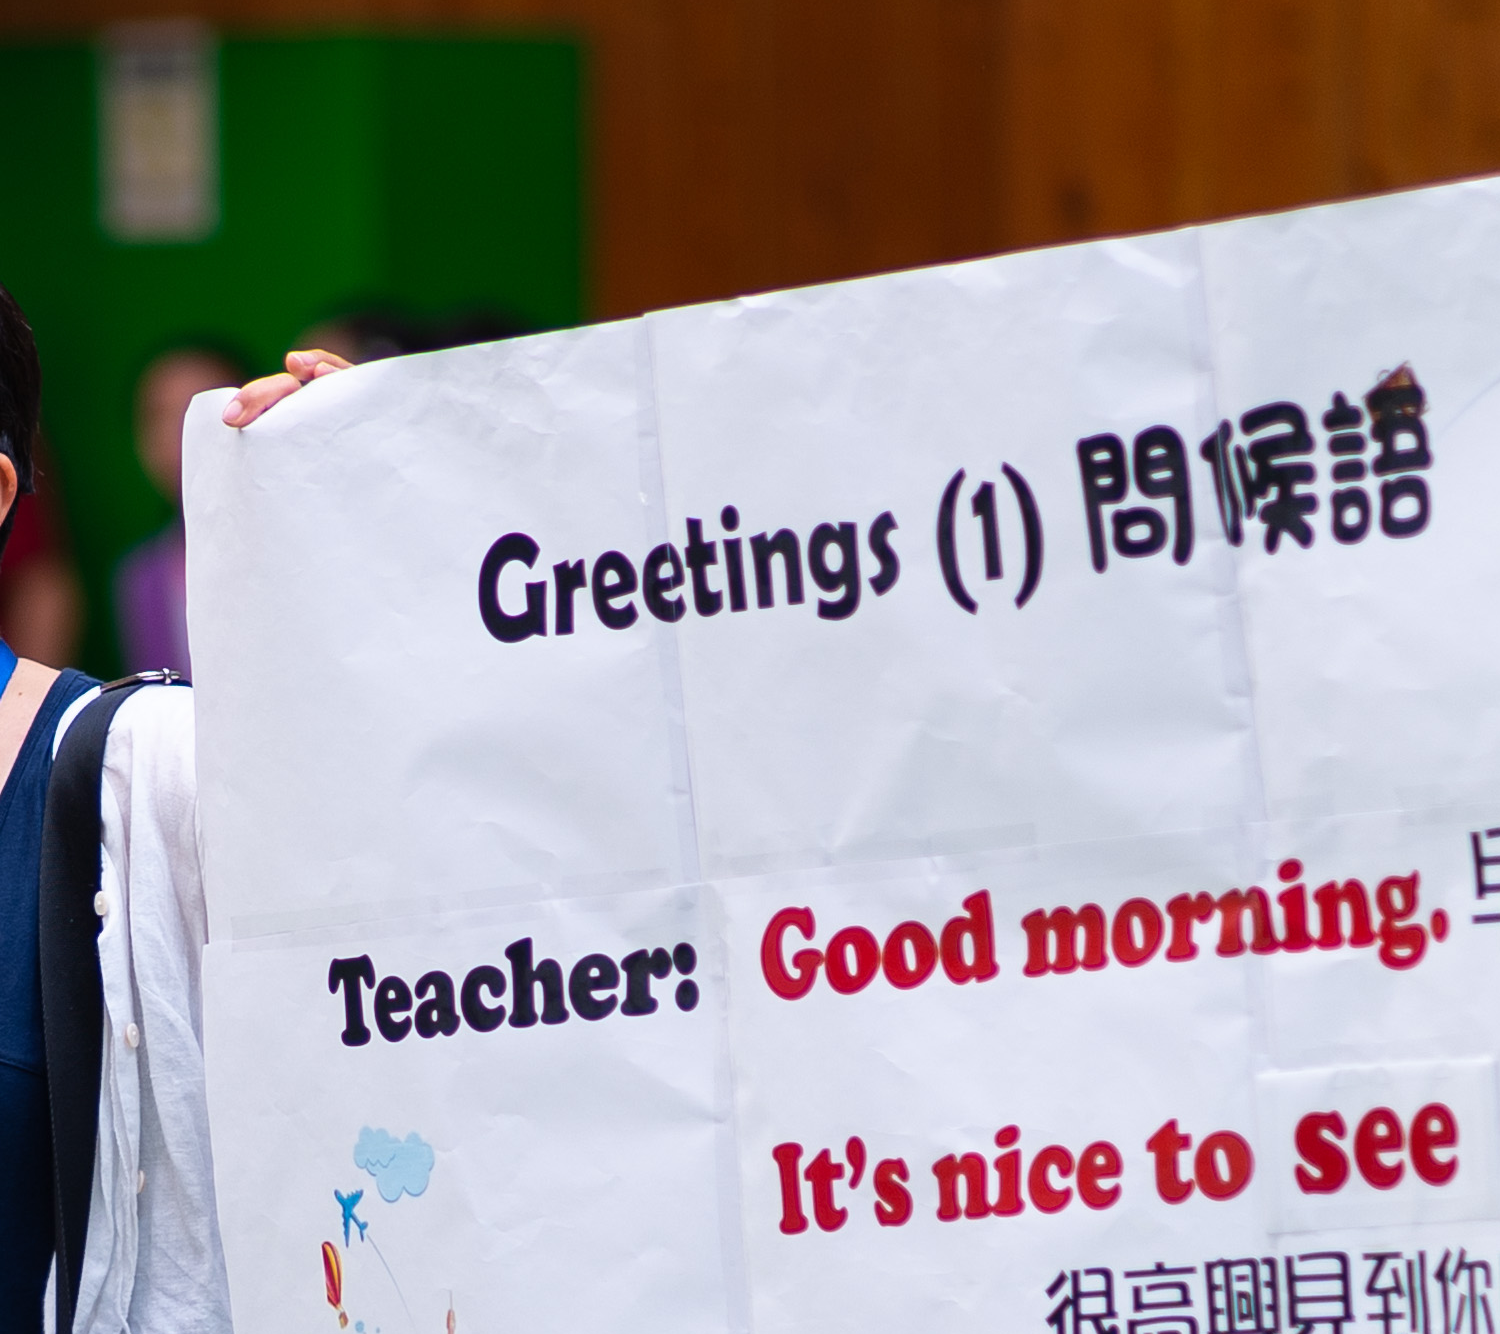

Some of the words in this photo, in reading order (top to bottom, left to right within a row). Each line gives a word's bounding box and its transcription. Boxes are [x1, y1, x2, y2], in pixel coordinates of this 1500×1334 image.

[479, 505, 899, 643] Greetings
[937, 463, 1043, 614] (1)
[1077, 393, 1431, 573] 問候語
[329, 938, 699, 1046] Teacher:
[760, 890, 999, 1000] Good
[1022, 859, 1449, 977] morning.
[773, 1137, 912, 1235] It's
[933, 1125, 1123, 1222] nice
[1150, 1119, 1253, 1204] to
[1295, 1103, 1458, 1193] see
